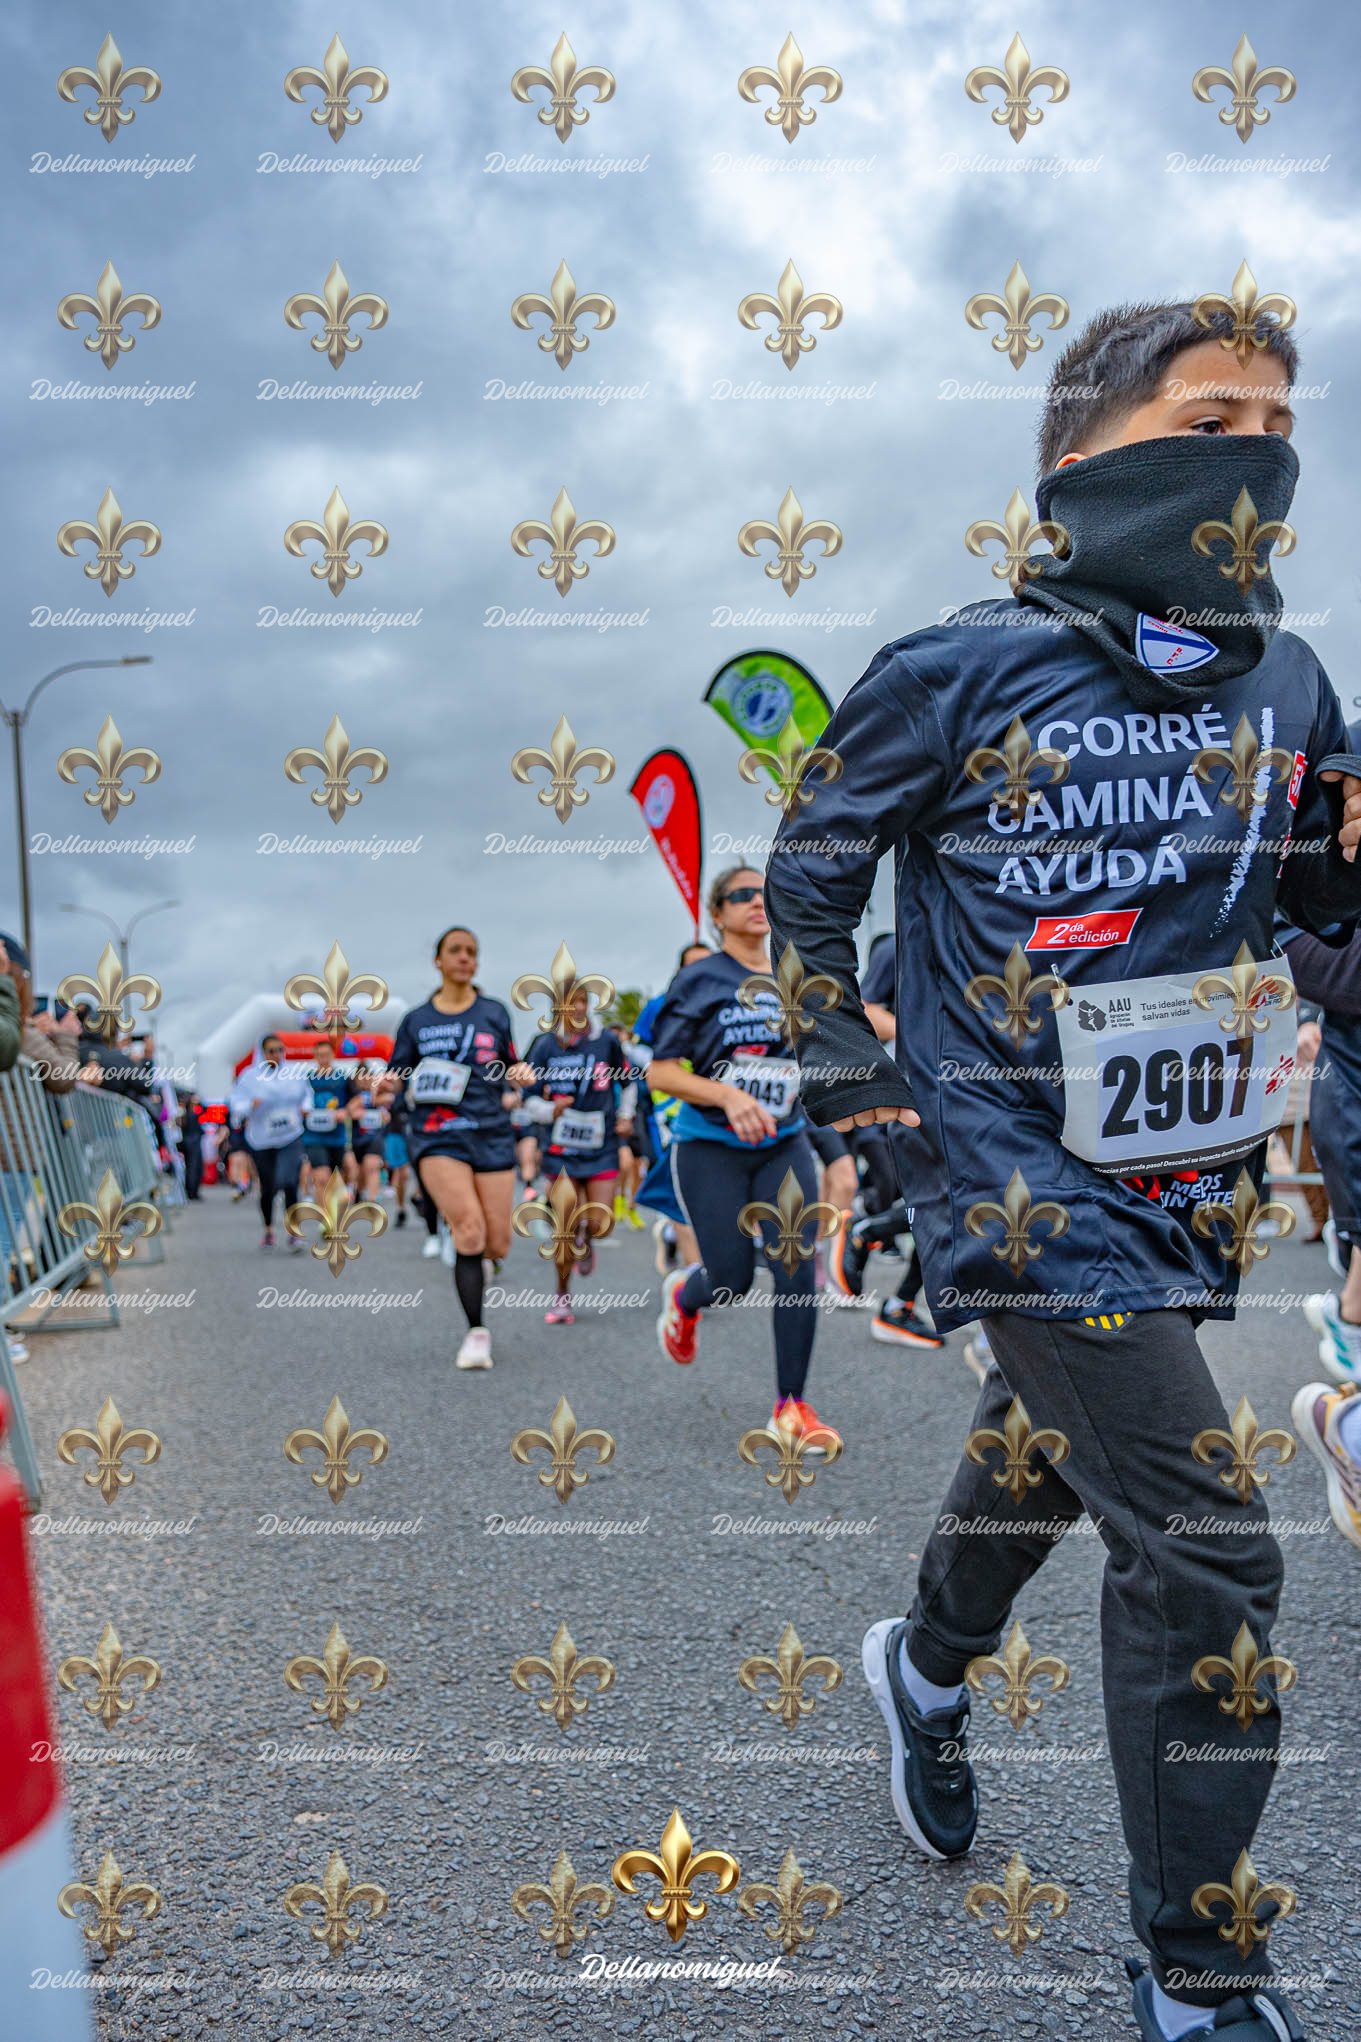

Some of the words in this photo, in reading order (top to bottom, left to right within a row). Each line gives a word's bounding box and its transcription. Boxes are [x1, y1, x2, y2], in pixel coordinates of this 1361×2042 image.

[1037, 704, 1231, 762] CORRÉ
[987, 764, 1213, 834] CAMINÁ
[995, 835, 1187, 895] AYUDÁ
[1068, 929, 1119, 944] edición
[1108, 997, 1132, 1013] AAU
[1140, 1002, 1157, 1011] Tus
[1158, 999, 1187, 1010] ideales
[1142, 1010, 1169, 1021] salvan
[1170, 1008, 1191, 1017] vidas
[1101, 1036, 1254, 1138] 2907
[1130, 1163, 1146, 1171] cada
